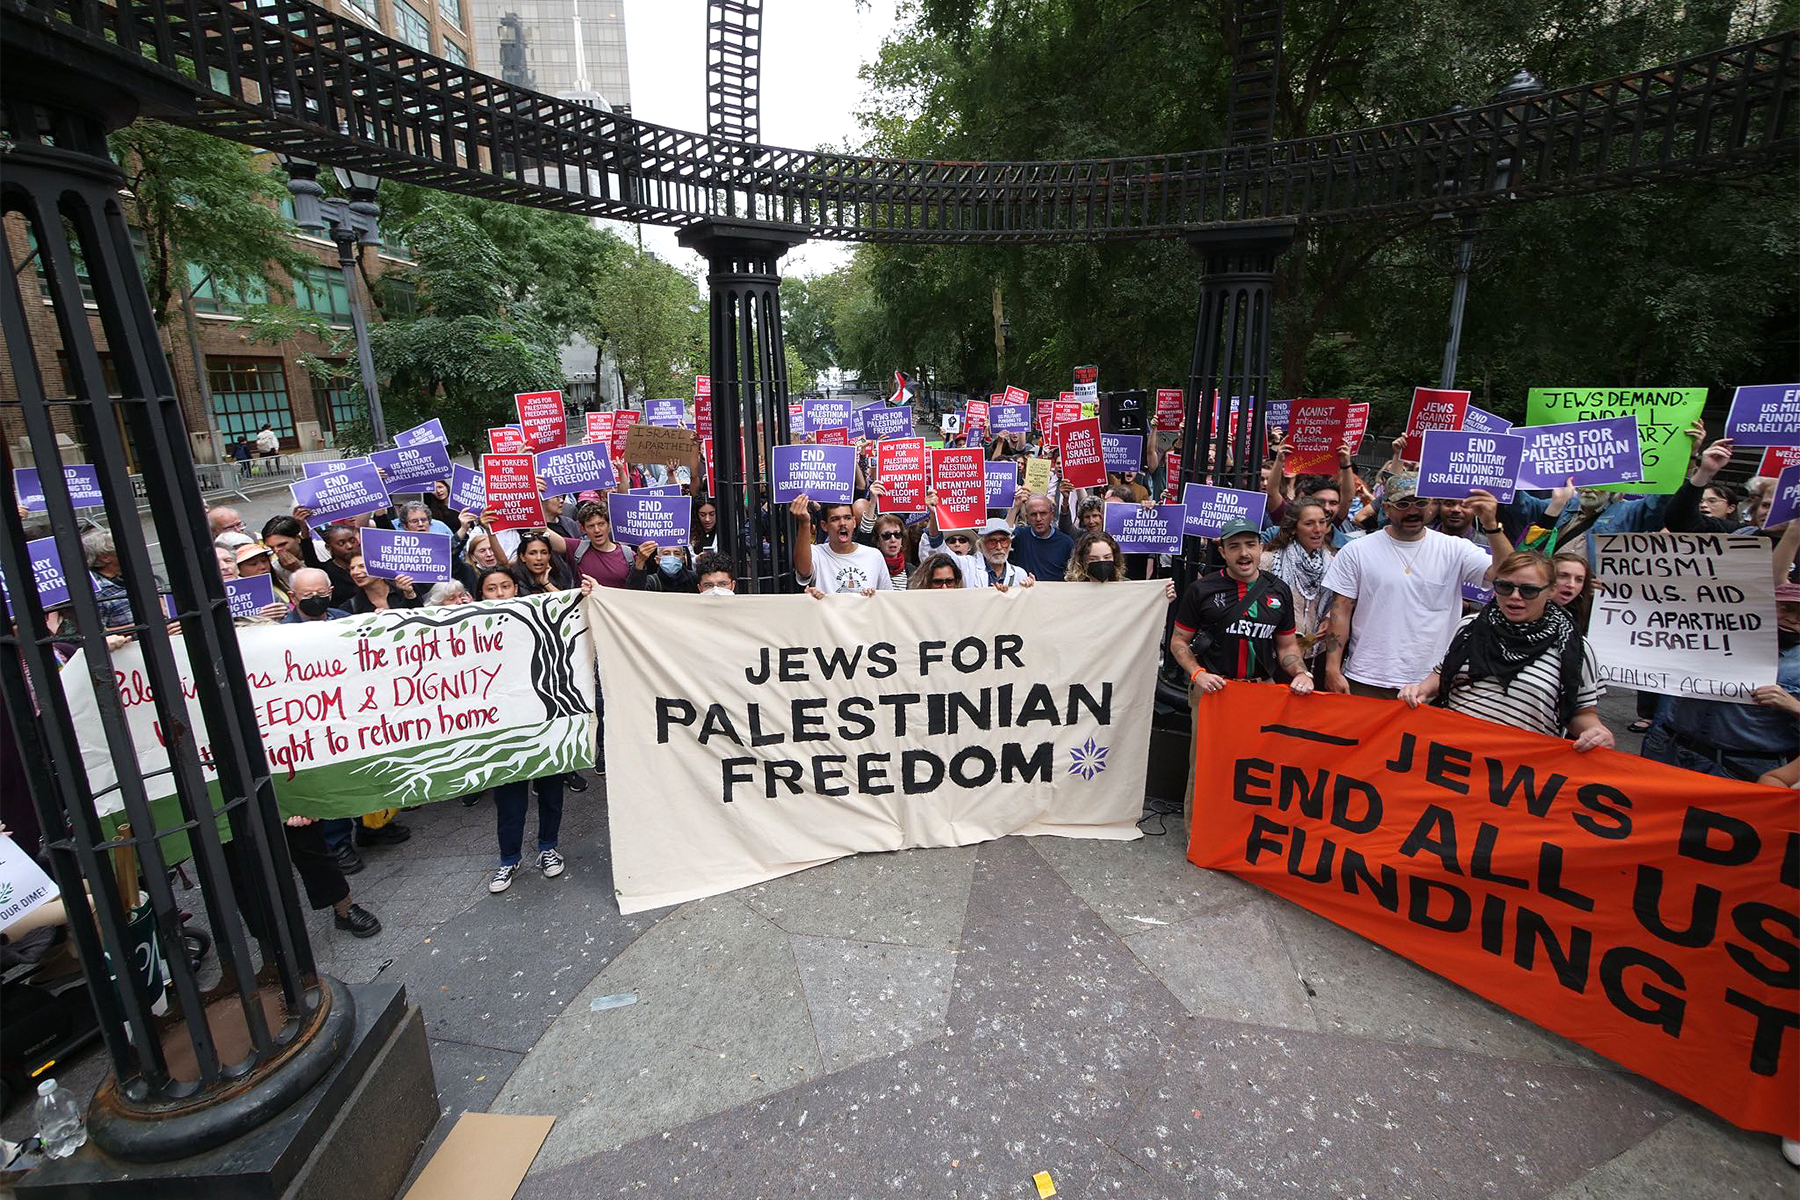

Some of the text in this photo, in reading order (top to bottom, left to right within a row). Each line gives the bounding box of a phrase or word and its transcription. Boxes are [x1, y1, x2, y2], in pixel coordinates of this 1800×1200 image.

[1543, 392, 1690, 408] JEWS DEMAND:
[1298, 407, 1335, 417] AGAINST
[1423, 402, 1454, 414] JEWS
[1761, 403, 1778, 413] US
[1416, 412, 1457, 423] AGAINST
[1468, 411, 1488, 423] END
[1759, 413, 1800, 423] FUNDI
[867, 419, 908, 428] PALESTINIAN
[873, 425, 903, 434] FREEDOM
[1736, 423, 1782, 432] ISRAELI
[1068, 430, 1090, 441] JEWS
[1532, 428, 1614, 448] JEWS FOR
[1066, 438, 1095, 450] AGAINST
[1102, 438, 1119, 446] END
[1468, 438, 1496, 453] END
[399, 449, 420, 461] END
[801, 450, 825, 461] END
[1067, 448, 1095, 458] ISRAELI
[1521, 440, 1630, 462] PALESTINIAN
[400, 456, 432, 468] MILITARY
[548, 450, 595, 466] JEWS FOR
[1064, 456, 1100, 467] APARTHEID
[1450, 452, 1506, 466] US MILITARY
[394, 465, 422, 476] FUNDING
[541, 459, 606, 478] PALESTINIAN
[789, 462, 836, 472] US MILITARY
[1449, 463, 1504, 476] FUNDING TO
[1535, 456, 1614, 475] FREEDOM
[411, 466, 449, 480] APARTHEID
[552, 471, 600, 486] FREEDOM
[789, 472, 836, 480] FUNDING TO
[881, 473, 922, 482] NETANYAHU
[324, 475, 349, 488] END
[779, 481, 849, 490] ISRAELI APARTHEID
[936, 480, 981, 490] NETANYAHU
[1428, 473, 1513, 488] ISRAELI APARTHEID
[328, 480, 363, 496] MILITARY
[318, 493, 356, 507] FUNDING
[340, 492, 383, 509] APARTHEID
[941, 496, 978, 505] WELCOME
[1216, 492, 1238, 505] END
[495, 507, 534, 515] WELCOME
[638, 500, 662, 512] END
[950, 504, 970, 513] HERE
[1214, 504, 1248, 515] MILITARY
[638, 512, 673, 520] MILITARY
[1136, 509, 1158, 519] END
[1200, 510, 1235, 521] FUNDING
[627, 519, 661, 528] FUNDING
[1186, 516, 1215, 527] ISRAELI
[617, 526, 685, 536] ISRAELI APARTHEID
[394, 535, 419, 546] END
[1601, 534, 1762, 556] ZIONISM =
[392, 547, 432, 556] MILITARY
[381, 554, 419, 564] FUNDING
[370, 560, 446, 572] ISRAELI APARTHEID
[1601, 557, 1718, 580] RACISM!
[40, 568, 58, 580] TO
[836, 567, 868, 582] BELIKIN
[1600, 582, 1745, 604] NO U.S. AID
[1600, 607, 1762, 631] TO APARTHEID
[1630, 630, 1732, 656] ISRAEL!
[285, 650, 346, 684] have
[353, 638, 388, 672] the
[396, 628, 442, 678] right
[446, 628, 466, 658] to
[472, 625, 504, 654] live
[745, 634, 1024, 684] JEWS FOR
[1598, 664, 1756, 698] OCIALIST ACTION
[358, 686, 378, 712] &
[393, 664, 502, 706] DIGNITY
[654, 682, 1113, 748] PALESTINIAN
[262, 704, 500, 782] ight to return home
[722, 741, 1054, 803] FREEDOM
[1386, 732, 1633, 840] JEWS
[1233, 757, 1800, 991] END ALL US
[0, 886, 48, 920] OUR DIME!
[1246, 815, 1688, 1038] FUNDING
